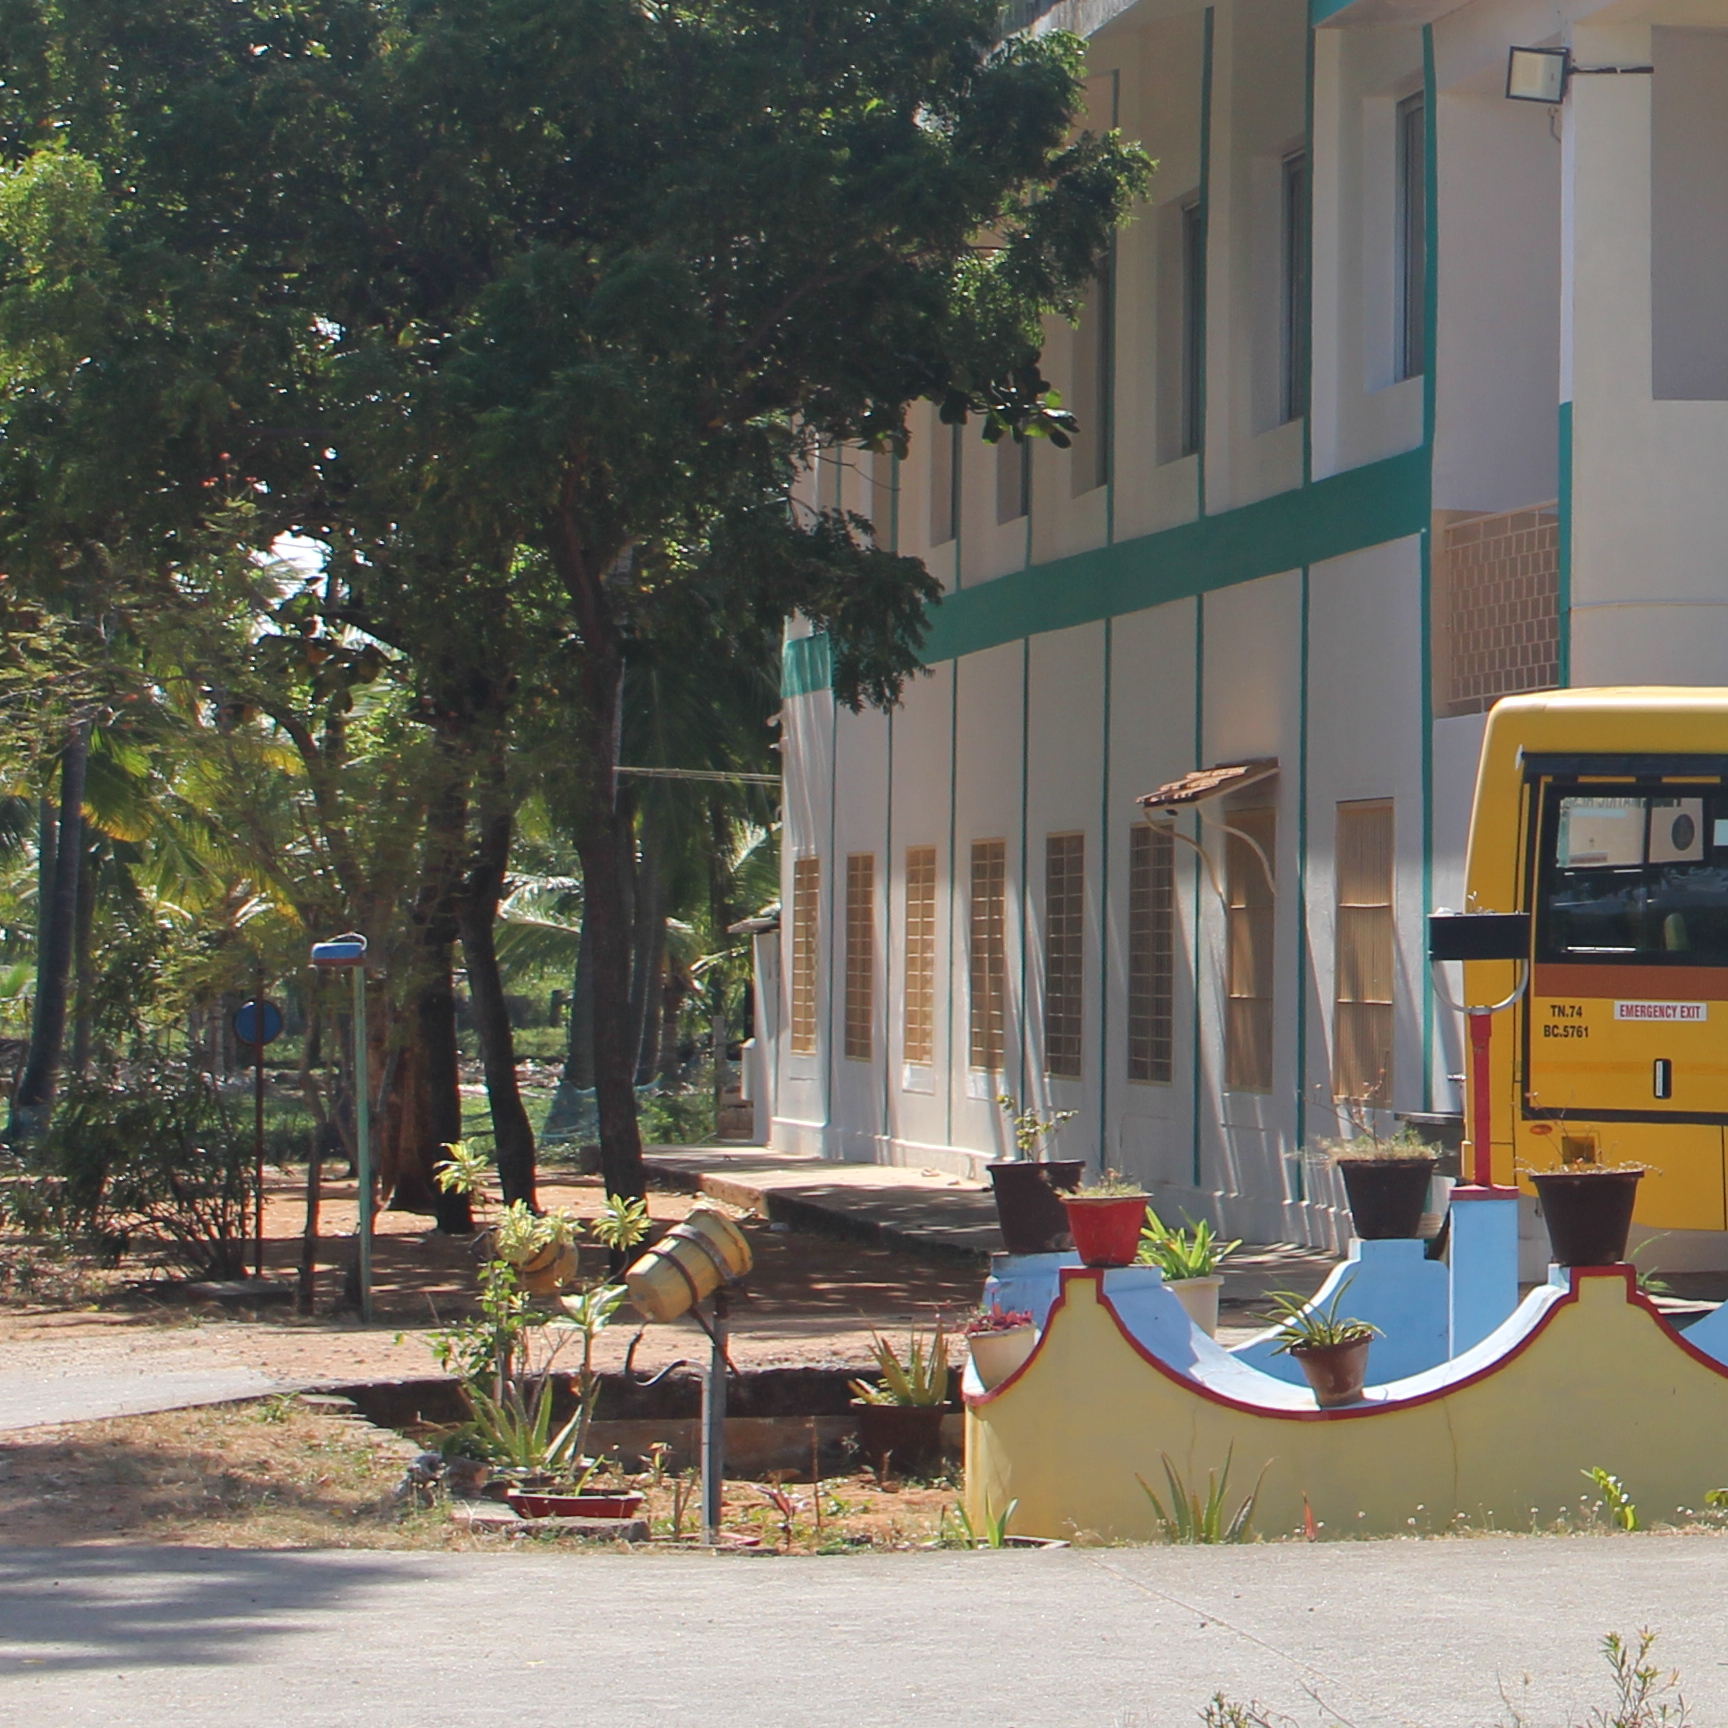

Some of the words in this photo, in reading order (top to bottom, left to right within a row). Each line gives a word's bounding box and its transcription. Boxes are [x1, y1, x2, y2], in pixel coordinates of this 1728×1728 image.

[1550, 1004, 1583, 1018] TN.74
[1619, 1004, 1677, 1019] EMERGENCY
[1680, 1004, 1701, 1019] EXIT
[1543, 1024, 1589, 1038] BC.5761
